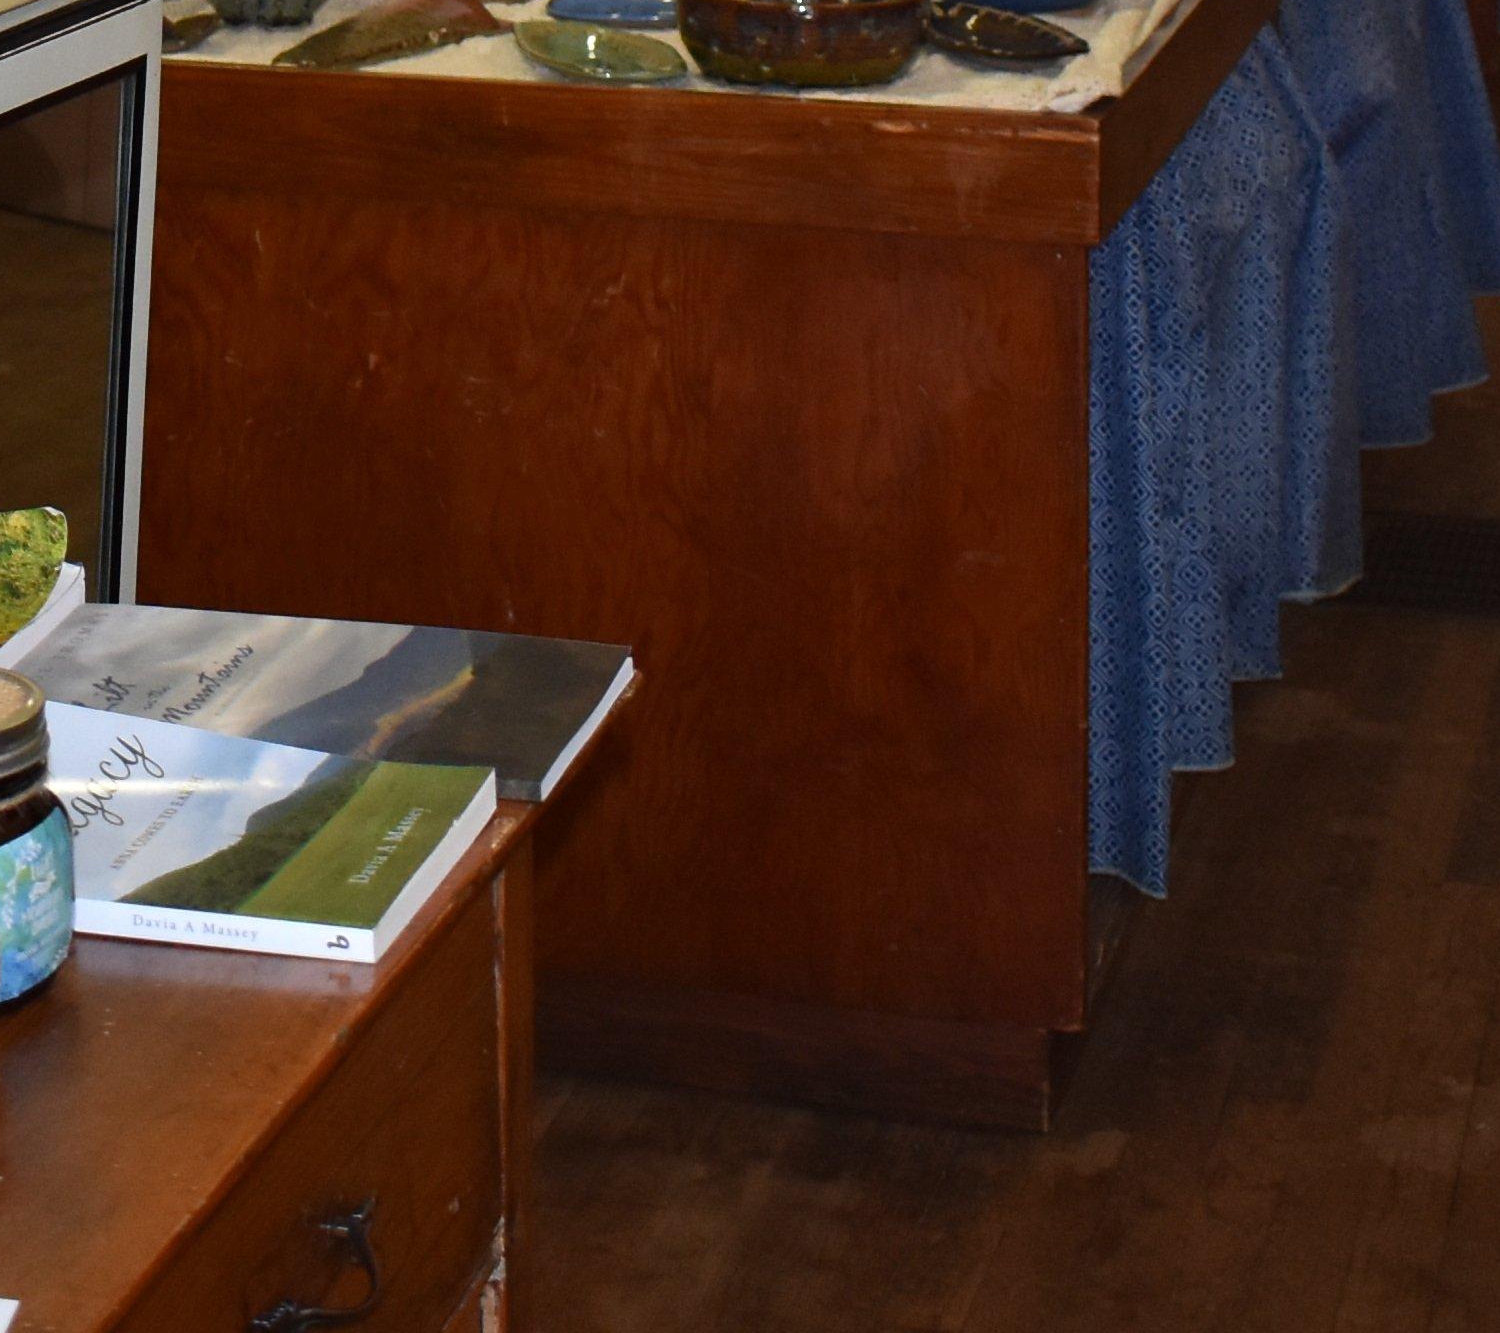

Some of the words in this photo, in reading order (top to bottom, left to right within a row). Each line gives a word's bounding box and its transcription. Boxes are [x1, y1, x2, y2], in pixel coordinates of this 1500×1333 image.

[348, 847, 379, 885] Davia
[376, 836, 390, 850] A
[383, 805, 432, 846] Massey
[131, 912, 178, 933] Davia
[183, 918, 198, 933] A
[202, 921, 260, 941] Massey
